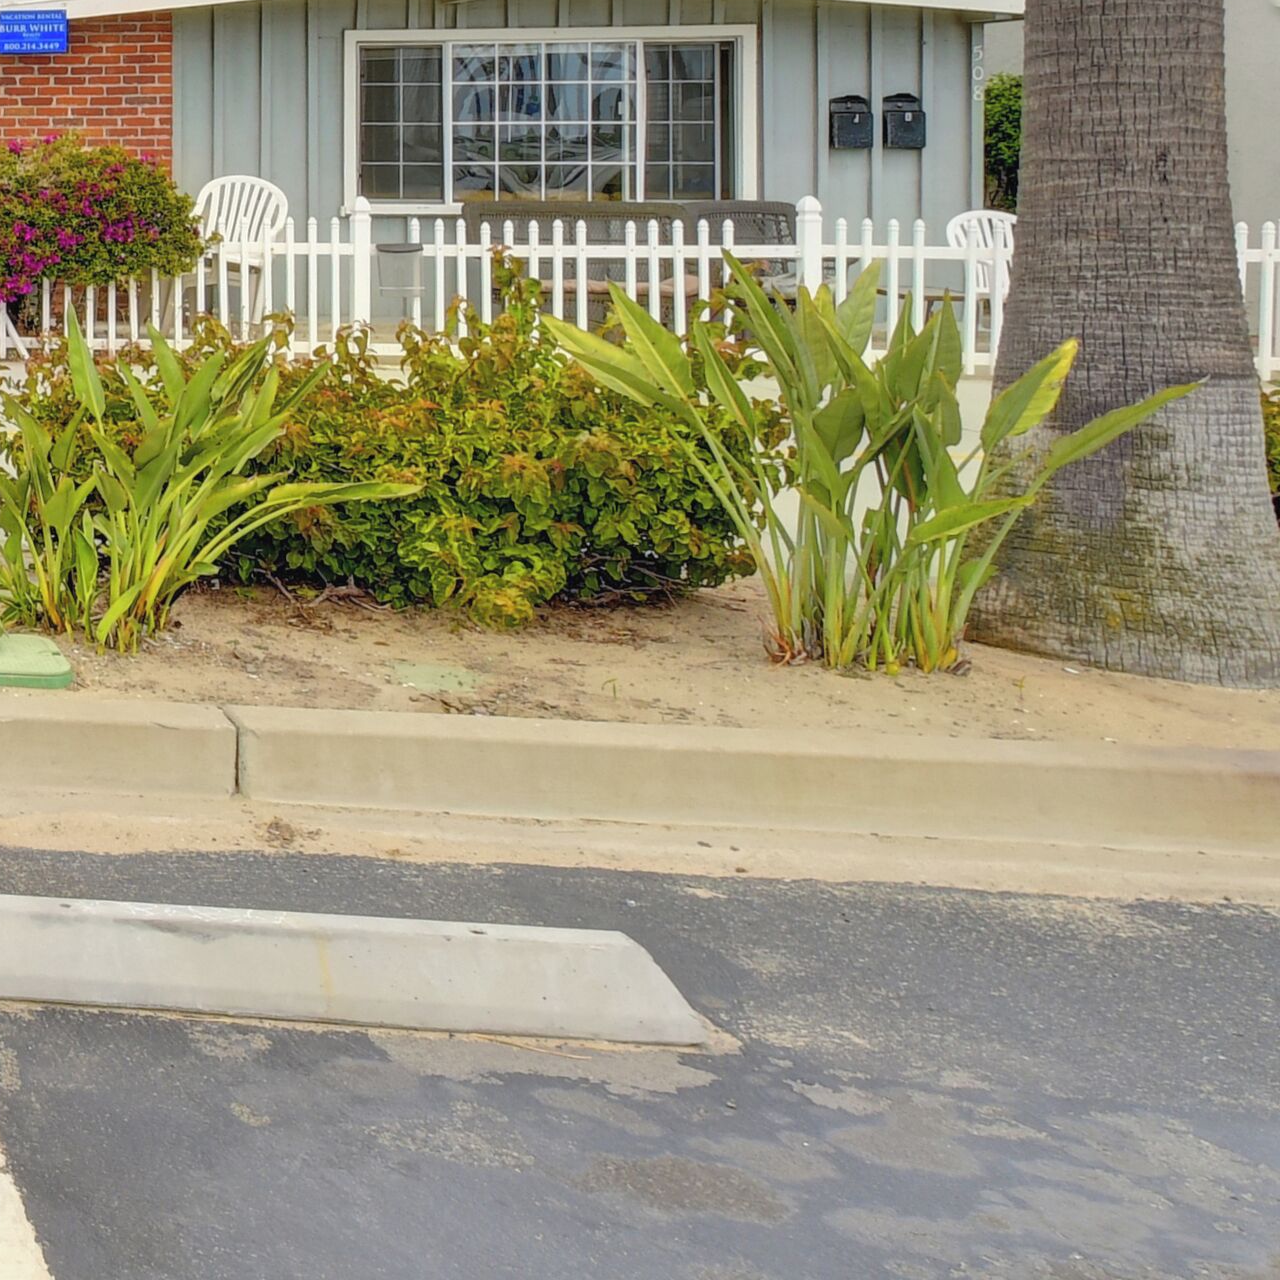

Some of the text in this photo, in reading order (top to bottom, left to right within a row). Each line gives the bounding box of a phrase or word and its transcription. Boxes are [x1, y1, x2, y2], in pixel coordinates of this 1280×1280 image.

[0, 23, 65, 33] BURR WHITE
[3, 42, 60, 51] 800.214.3449
[972, 45, 985, 101] 508
